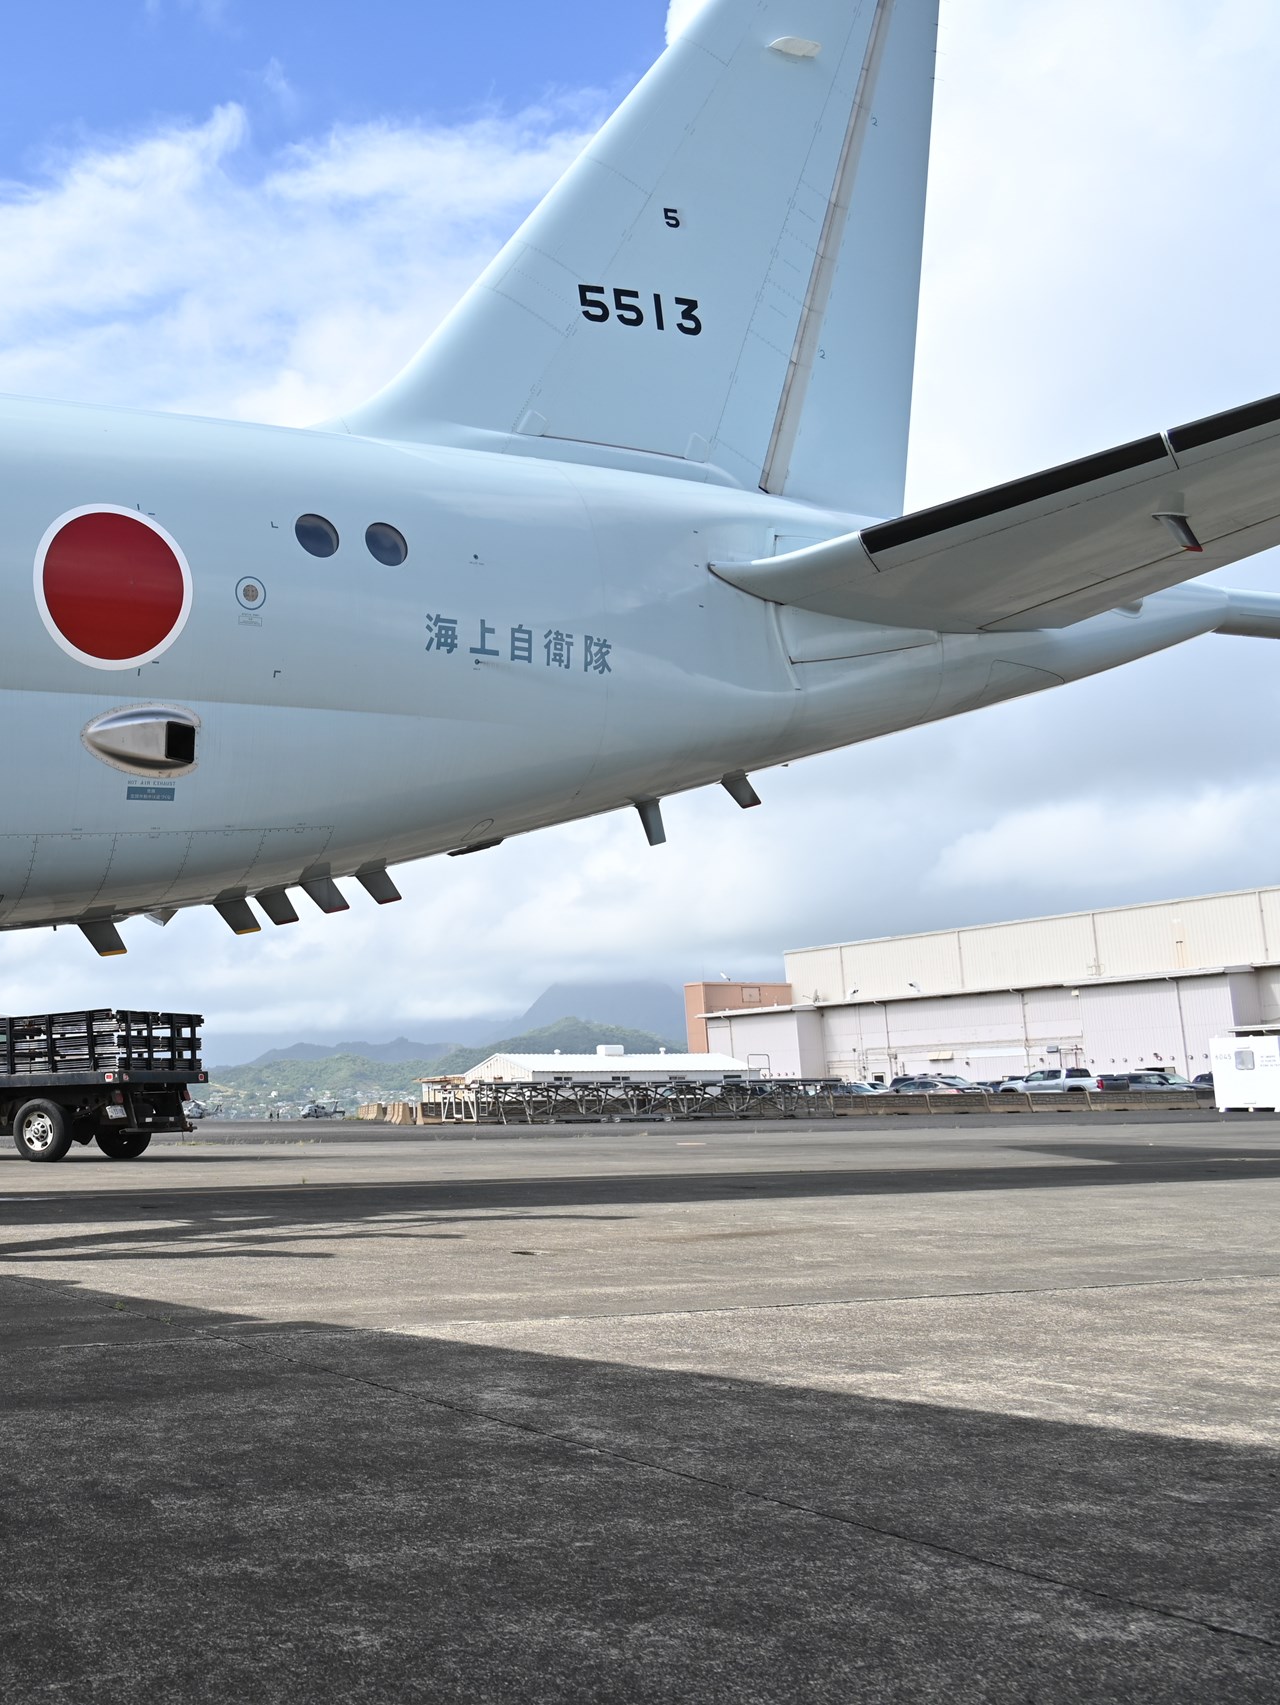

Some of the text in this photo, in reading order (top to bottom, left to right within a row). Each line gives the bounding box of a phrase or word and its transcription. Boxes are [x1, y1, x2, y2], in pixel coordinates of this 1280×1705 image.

[663, 207, 681, 229] 5
[577, 284, 703, 337] 5513
[425, 613, 612, 675] 海上自衛隊
